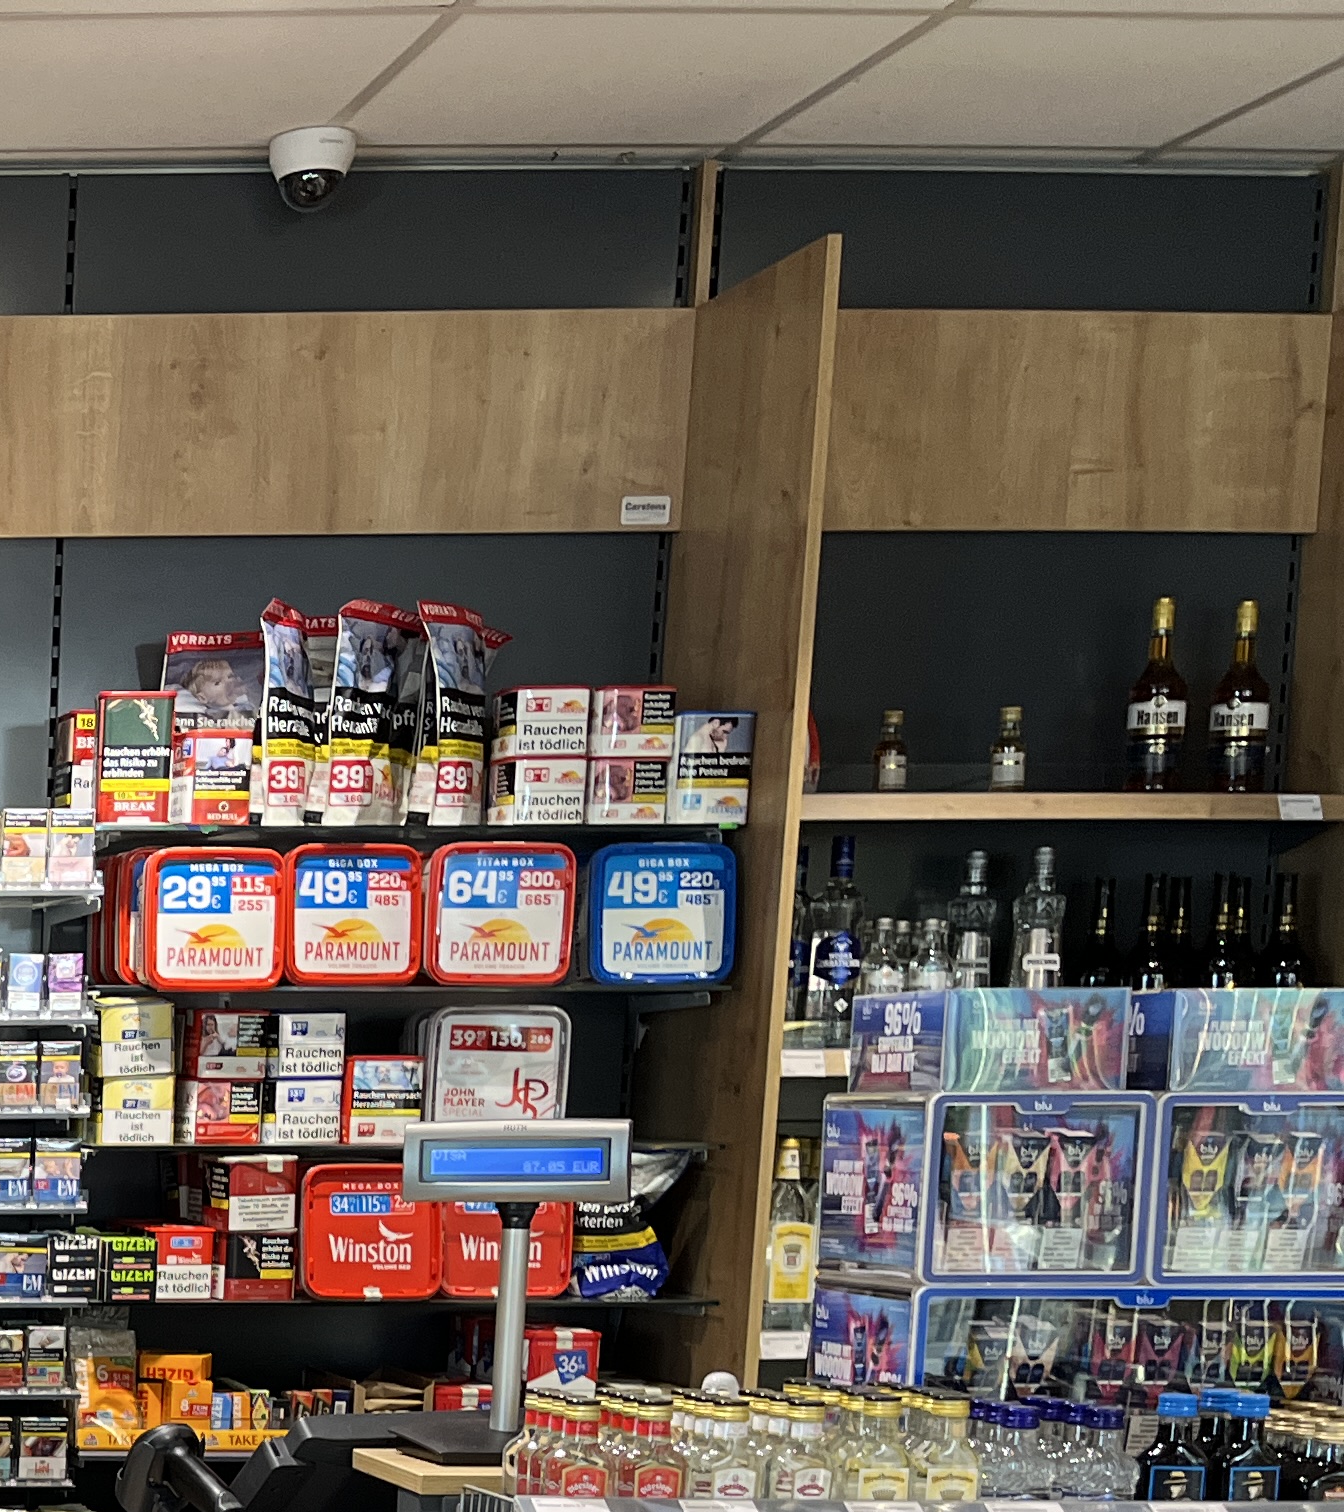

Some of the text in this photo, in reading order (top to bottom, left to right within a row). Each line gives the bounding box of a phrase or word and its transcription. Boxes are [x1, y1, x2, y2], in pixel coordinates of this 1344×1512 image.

[172, 634, 232, 646] VORRATS
[523, 724, 583, 736] Rauchen
[518, 738, 585, 751] ist tödlich
[167, 947, 263, 967] PARAMOUNT
[304, 941, 400, 961] PARAMOUNT
[450, 942, 550, 962] PARAMOUNT
[613, 941, 713, 961] PARAMOUNT
[285, 1048, 342, 1059] Rauchen
[281, 1061, 343, 1073] ist tödlich
[444, 1089, 475, 1098] JOHN
[443, 1098, 485, 1107] PLAYER
[442, 1108, 484, 1117] SPECIAL
[573, 1161, 600, 1173] EUR
[329, 1233, 412, 1263] Winston
